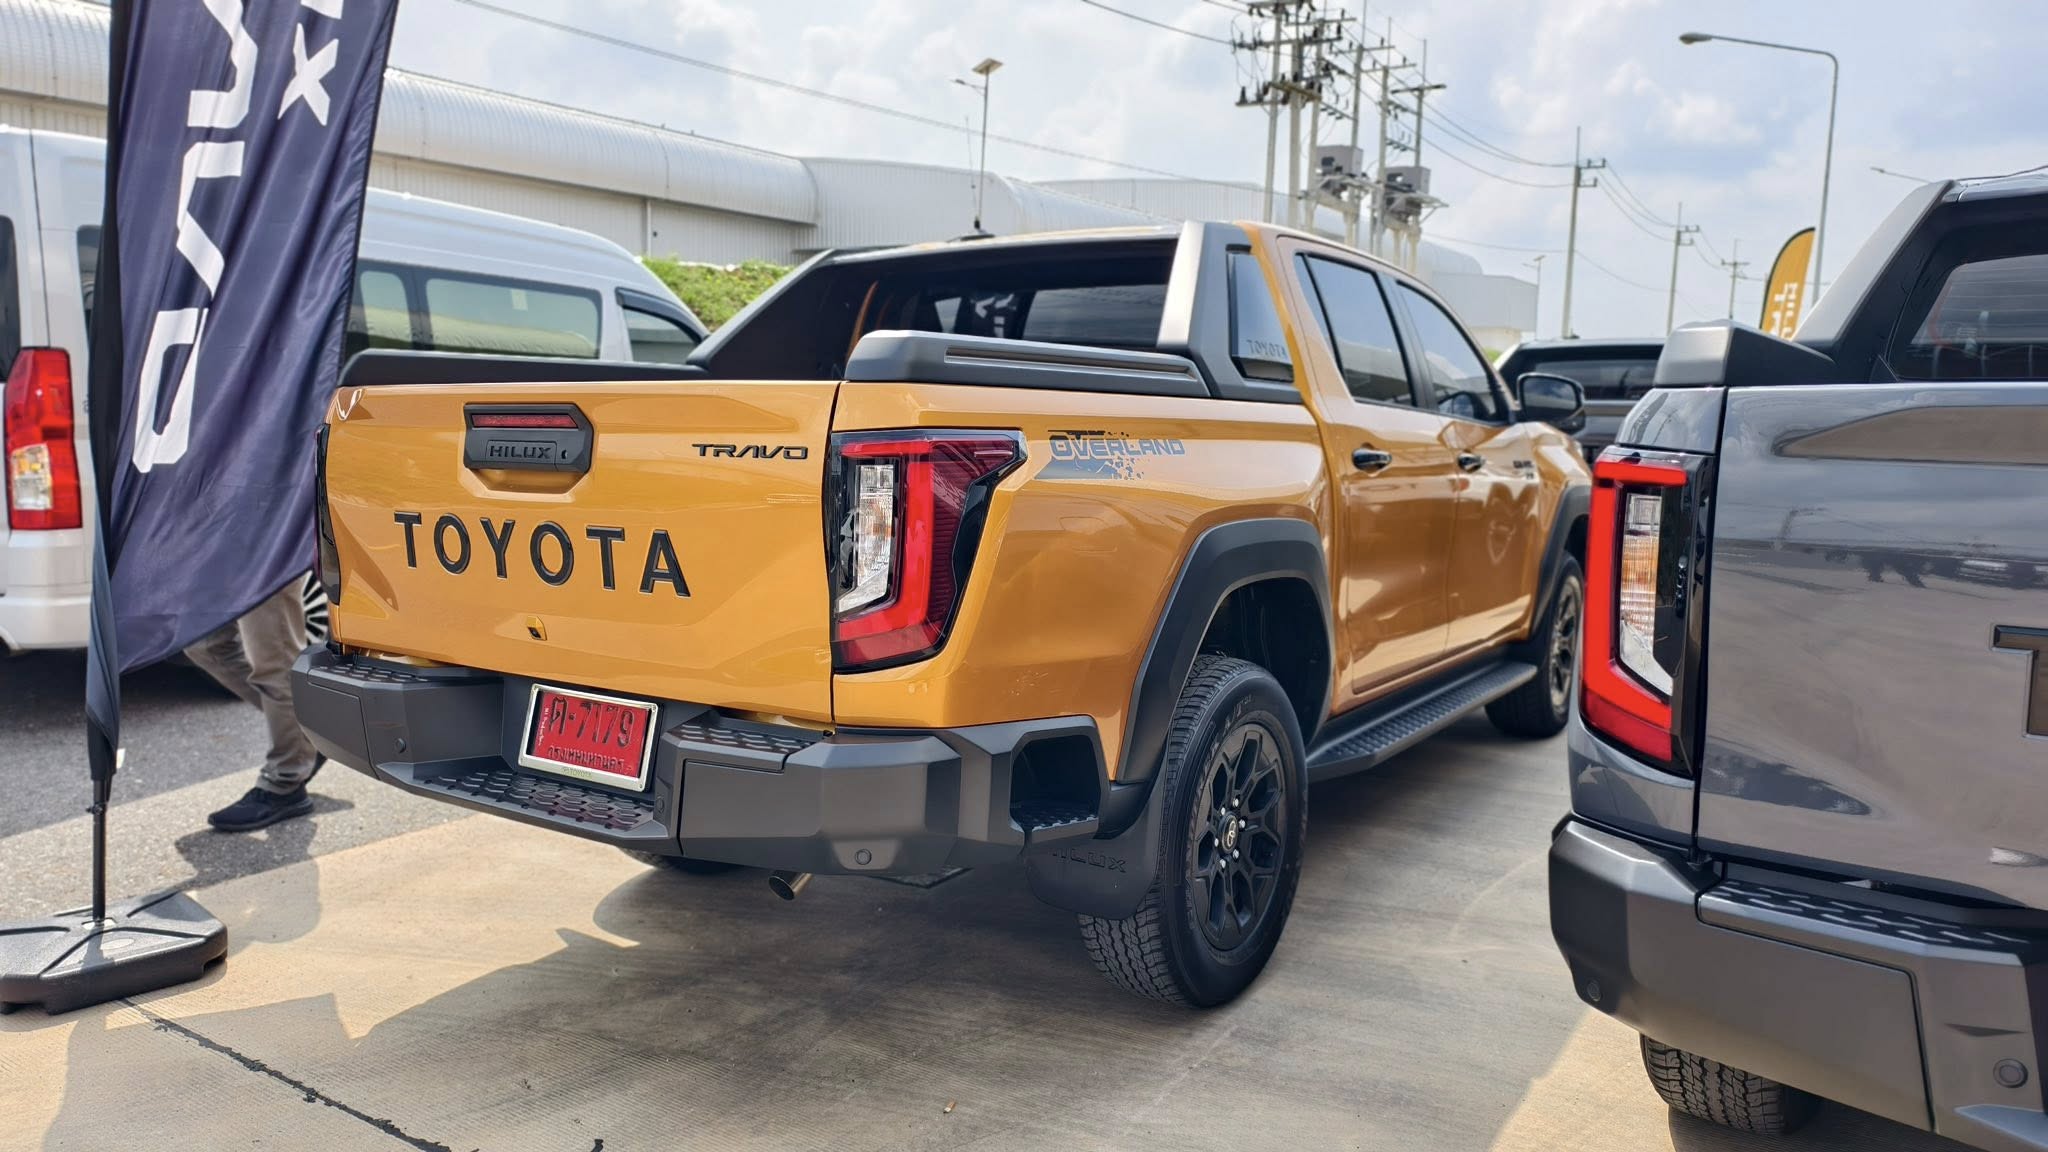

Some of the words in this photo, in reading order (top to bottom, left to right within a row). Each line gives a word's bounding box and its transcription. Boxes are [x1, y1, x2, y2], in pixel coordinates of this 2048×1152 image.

[1246, 339, 1288, 358] TOYOTA
[489, 445, 551, 460] HILUX
[691, 443, 809, 460] TRAVO
[1049, 434, 1186, 460] OVERLAND
[394, 511, 691, 597] TOYOTA
